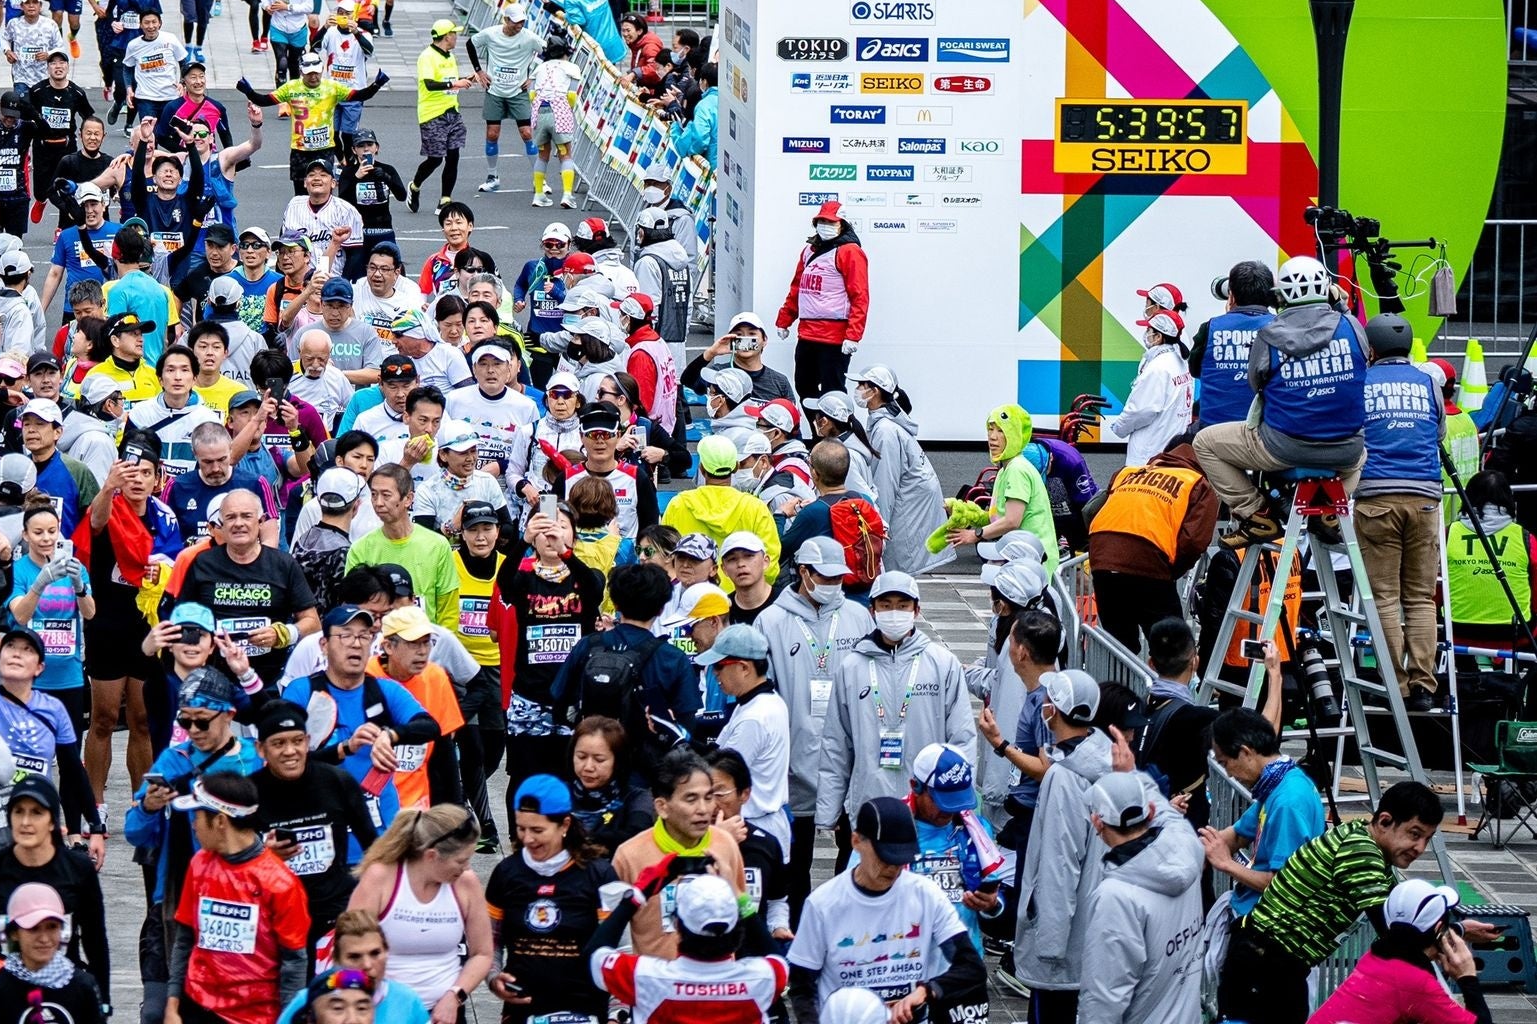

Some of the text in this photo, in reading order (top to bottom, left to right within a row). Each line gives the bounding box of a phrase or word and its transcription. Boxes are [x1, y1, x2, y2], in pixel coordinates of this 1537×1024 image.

[786, 40, 841, 52] TOKIO
[880, 41, 921, 57] asics
[791, 51, 835, 60] インカラミ
[863, 77, 922, 89] SEIKO
[940, 79, 985, 90] 第一生命
[788, 140, 824, 149] MIZUHO
[842, 139, 885, 148] こくみん共済
[899, 141, 941, 153] Salonpas
[1091, 148, 1211, 172] SEIKO
[810, 168, 856, 179] バスクリン
[869, 169, 911, 177] TOPPAN
[932, 166, 964, 174] 大和証券
[936, 174, 960, 182] グループ
[1280, 355, 1354, 379] CAMERA
[1285, 372, 1354, 386] TOKYO MARATHON
[1317, 386, 1336, 396] asics
[1364, 382, 1429, 398] SPONSOR
[1364, 396, 1430, 414] CAMERA
[1368, 412, 1430, 421] TOKYO MARATHON
[1396, 421, 1415, 429] asics
[488, 442, 512, 452] AHEAD
[1138, 488, 1173, 506] MARATHON
[1461, 534, 1509, 557] TV
[214, 588, 272, 600] CHICAGO
[214, 598, 258, 606] MARATHON
[235, 620, 265, 630] 東京メトロ
[544, 628, 575, 636] 東京メトロ
[538, 638, 570, 653] 96070
[938, 763, 960, 784] Move
[212, 906, 250, 918] 東京メトロ
[200, 918, 240, 938] 36805
[839, 963, 922, 980] ONE STEP AHEAD
[674, 982, 748, 996] TOSHIBA
[840, 980, 866, 988] TOKYO
[948, 1002, 988, 1023] Move
